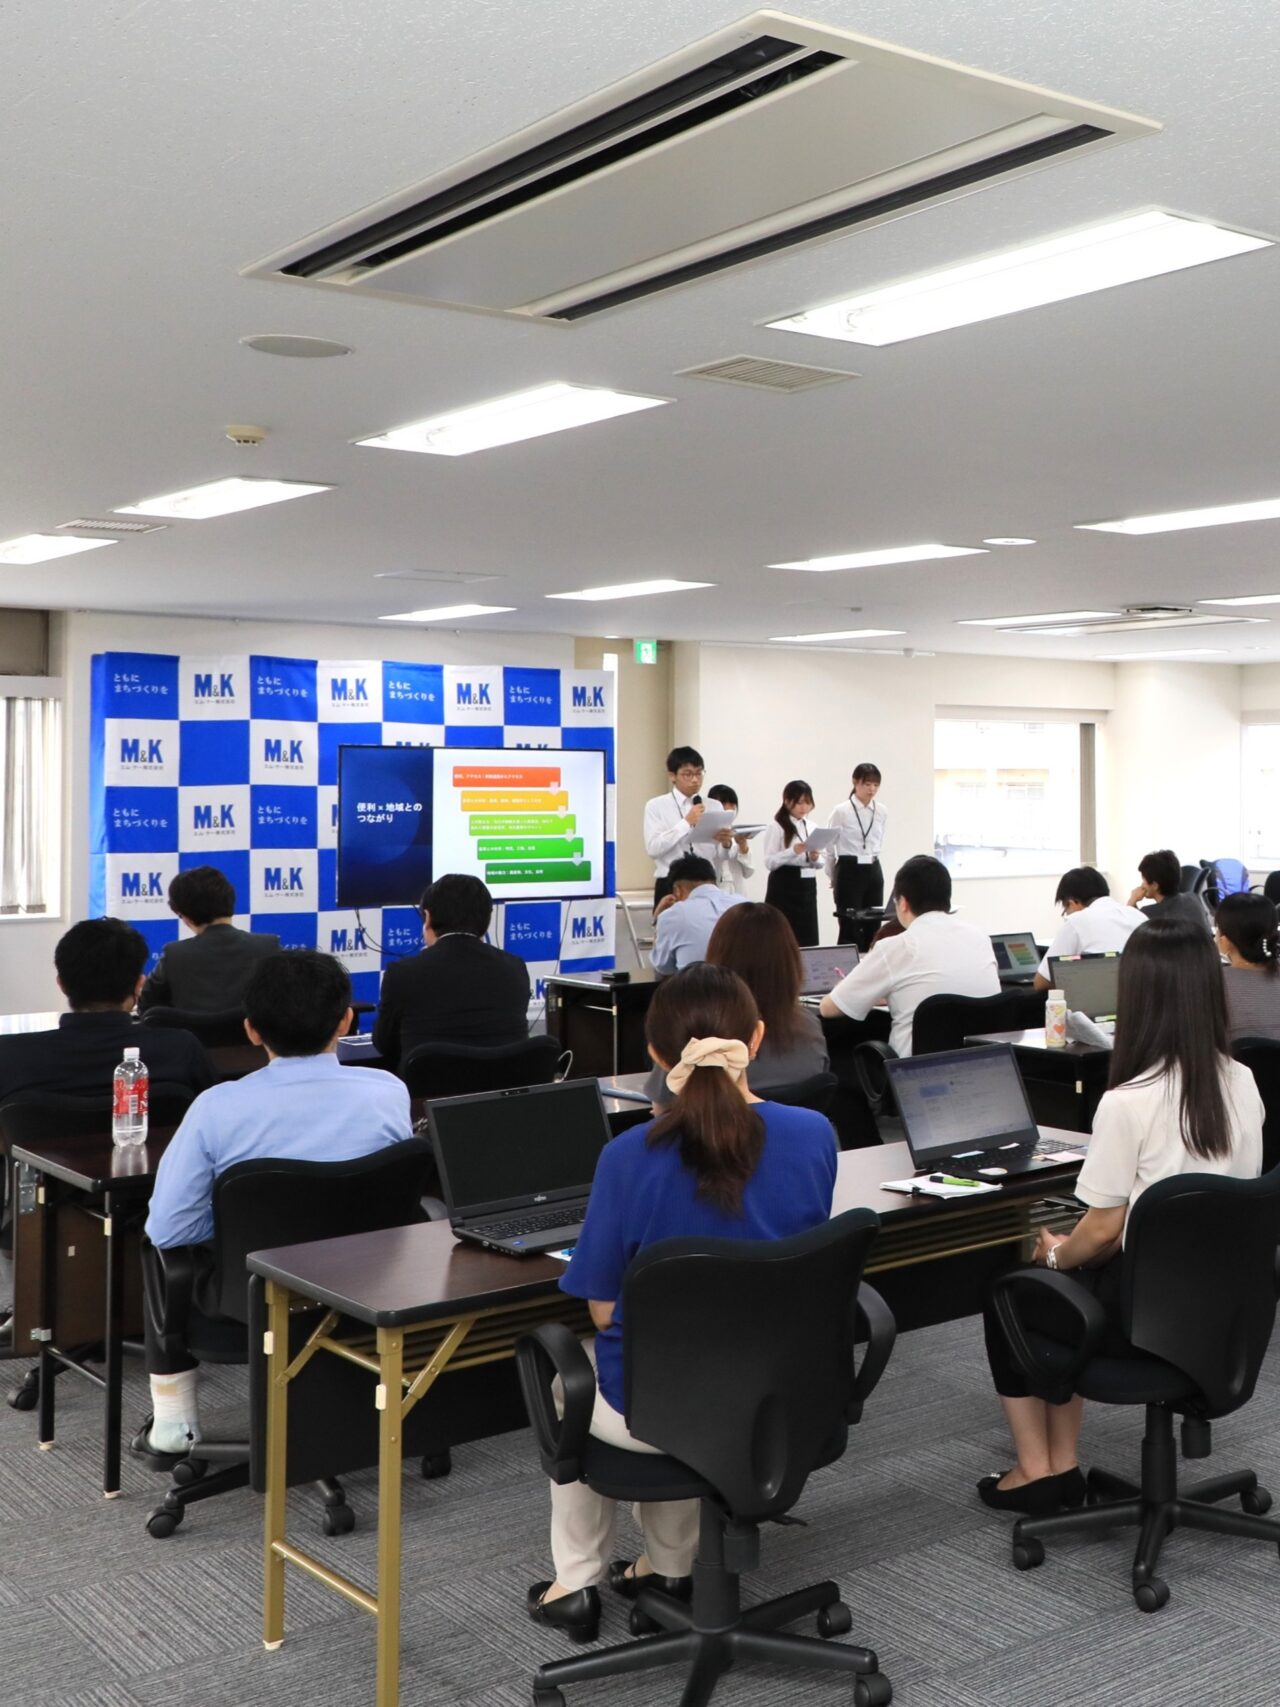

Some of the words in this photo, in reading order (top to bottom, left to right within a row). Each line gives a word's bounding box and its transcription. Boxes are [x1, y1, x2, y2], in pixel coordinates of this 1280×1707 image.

[114, 674, 139, 682] ともに
[257, 676, 281, 685] ともに
[115, 684, 168, 694] まちづくりを
[194, 674, 234, 697] M&K
[331, 678, 367, 700] M&K
[389, 681, 410, 690] ともに
[510, 686, 530, 694] ともに
[258, 686, 308, 697] まちづくりを
[390, 691, 435, 701] まちづくりを
[457, 683, 490, 704] M&K
[573, 686, 604, 707] M&K
[510, 695, 552, 704] まちづくりを
[121, 739, 163, 763] M&K
[265, 739, 303, 763] M&K
[113, 808, 139, 817] ともに
[258, 806, 281, 814] ともに
[194, 805, 234, 829] M&K
[258, 816, 307, 824] まちづくりを
[357, 814, 393, 823] つながり
[114, 819, 168, 827] まちづくりを
[265, 868, 303, 890] M&K
[122, 873, 163, 896] M&K
[388, 928, 410, 936] ともに
[510, 923, 530, 931] ともに
[572, 916, 604, 938] M&K
[331, 929, 367, 952] M&K
[510, 931, 552, 940] まちづくりを
